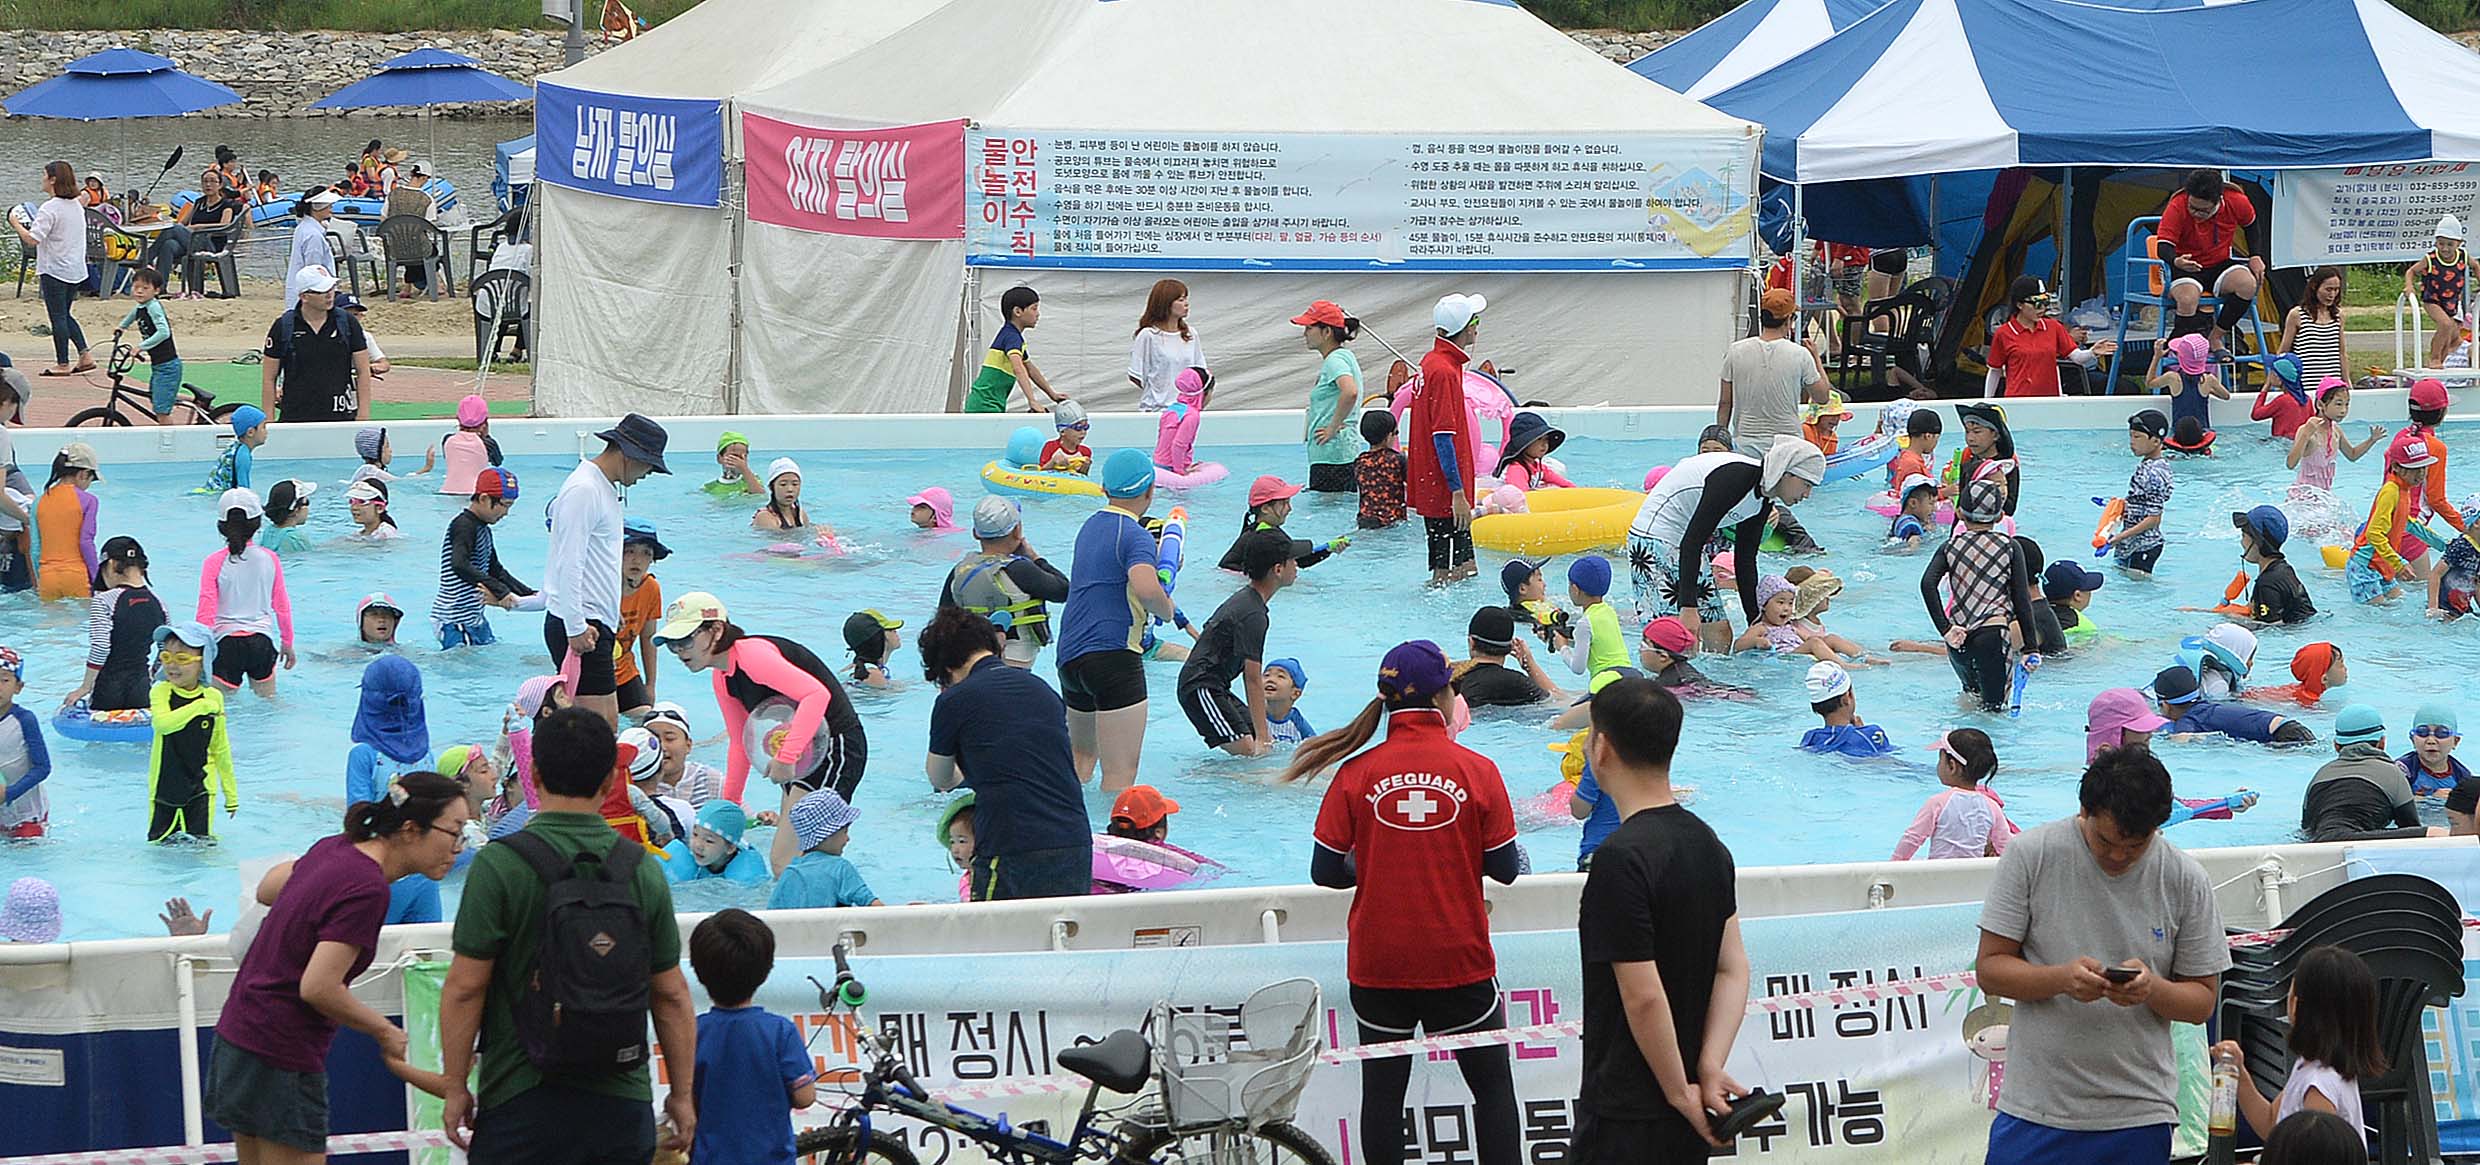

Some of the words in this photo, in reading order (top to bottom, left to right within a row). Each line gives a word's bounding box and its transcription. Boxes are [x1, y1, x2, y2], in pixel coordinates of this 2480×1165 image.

[573, 104, 614, 181] 남자
[613, 110, 677, 192] 탈의실
[1080, 139, 1106, 151] 피부병
[1111, 140, 1128, 151] 등이
[1131, 140, 1140, 151] 난
[1144, 140, 1179, 151] 어린이는
[1184, 140, 1218, 152] 물놀이를
[1223, 141, 1240, 152] 하지
[1243, 141, 1281, 153] 않습니다.
[1426, 143, 1446, 154] 음식
[1447, 143, 1466, 154] 등을
[1467, 143, 1496, 154] 먹으며
[1497, 144, 1542, 155] 물놀이장을
[1543, 144, 1571, 155] 들어갈
[1573, 144, 1583, 155] 수
[1584, 144, 1623, 155] 없습니다.
[1055, 155, 1090, 166] 공모양의
[1095, 156, 1121, 167] 튜브는
[1125, 156, 1160, 167] 물속에서
[1203, 157, 1229, 168] 놓치면
[1233, 158, 1277, 169] 위험하므로
[1412, 161, 1429, 172] 수영
[1432, 161, 1450, 172] 도중
[1453, 161, 1470, 172] 추울
[1515, 162, 1549, 173] 따뜻하게
[1552, 162, 1569, 173] 하고
[1573, 162, 1598, 173] 휴식을
[1602, 162, 1647, 173] 취하십시오.
[784, 135, 836, 216] 여자
[834, 138, 911, 223] 탈의실
[1112, 168, 1130, 180] 몸에
[1154, 168, 1164, 180] 수
[1167, 169, 1185, 180] 있는
[1189, 169, 1216, 180] 튜브가
[1218, 169, 1266, 181] 안전합니다.
[982, 138, 1009, 229] 물놀이
[1055, 183, 1081, 195] 음식을
[1085, 183, 1102, 195] 먹은
[1107, 184, 1133, 196] 후에는
[1136, 184, 1155, 196] 30분
[1160, 184, 1178, 196] 이상
[1181, 184, 1207, 196] 시간이
[1211, 184, 1228, 196] 지난
[1232, 184, 1241, 196] 후
[1245, 185, 1279, 197] 물놀이를
[1283, 185, 1312, 197] 합니다.
[1411, 179, 1437, 191] 위험한
[1441, 179, 1467, 191] 상황의
[1469, 179, 1495, 191] 사람을
[1499, 179, 1533, 191] 발견하면
[1536, 180, 1562, 191] 주위에
[1566, 180, 1592, 191] 소리쳐
[1594, 180, 1640, 191] 알리십시오.
[2409, 181, 2478, 191] 032-859-5999
[1009, 139, 1039, 261] 안전수칙
[1054, 199, 1081, 211] 수영을
[1085, 199, 1103, 211] 하기
[1107, 200, 1134, 212] 전에는
[1136, 200, 1163, 212] 반드시
[1197, 200, 1241, 212] 준비운동을
[1244, 201, 1274, 213] 합시다.
[1411, 197, 1437, 209] 교사나
[1440, 197, 1461, 209] 부모,
[1464, 197, 1516, 209] 안전요원들이
[1548, 197, 1557, 209] 수
[1560, 198, 1577, 209] 있는
[1580, 198, 1606, 209] 곳에서
[1609, 198, 1643, 209] 물놀이를
[1673, 198, 1703, 209] 합니다.
[1054, 215, 1080, 227] 수면이
[1084, 215, 1120, 227] 자기가슴
[1123, 216, 1142, 228] 이상
[1145, 216, 1180, 228] 올라오는
[1184, 216, 1219, 228] 어린이는
[1283, 217, 1309, 229] 주시기
[1312, 218, 1350, 229] 바랍니다.
[1411, 215, 1436, 226] 가급적
[1440, 215, 1465, 226] 잠수는
[1053, 230, 1073, 241] 물에
[1074, 230, 1093, 241] 처음
[1095, 230, 1132, 241] 들어가기
[1135, 230, 1162, 242] 전에는
[1165, 230, 1201, 242] 심장에서
[1204, 230, 1213, 242] 먼
[1320, 231, 1338, 243] 가슴
[1409, 232, 1429, 243] 45분
[1432, 232, 1462, 243] 물놀이,
[1465, 232, 1485, 243] 15분
[1487, 232, 1530, 243] 휴식시간을
[1534, 231, 1569, 243] 준수하고
[1571, 231, 1616, 243] 안전요원의
[1617, 231, 1669, 243] 지시(통제)에
[1054, 242, 1072, 253] 물에
[1076, 242, 1102, 253] 적시며
[1106, 243, 1162, 254] 들어가십시오.
[1410, 244, 1454, 255] 따라주시기
[1457, 245, 1495, 256] 바랍니다.
[1364, 772, 1469, 804] LIFEGUARD
[1765, 973, 1816, 1041] 매
[1829, 966, 1928, 1039] 정시
[947, 1010, 1051, 1080] 정시
